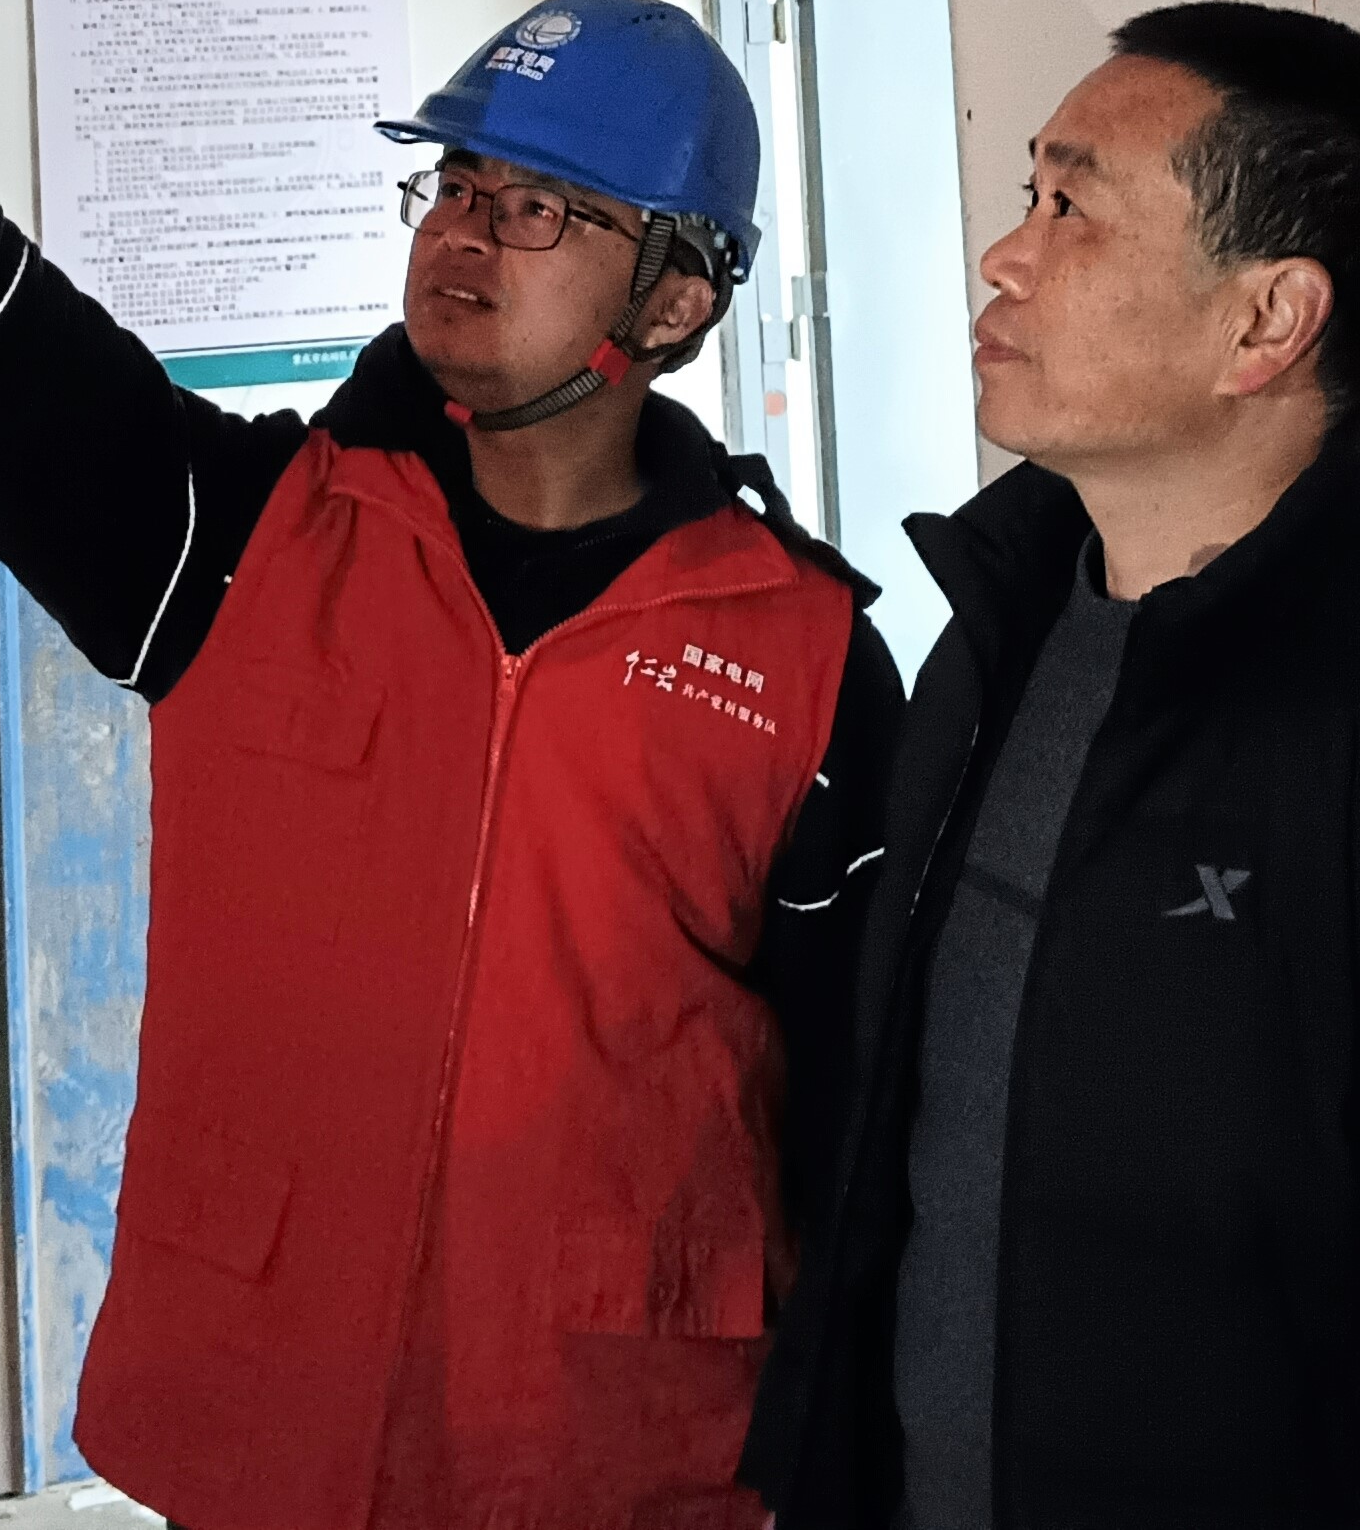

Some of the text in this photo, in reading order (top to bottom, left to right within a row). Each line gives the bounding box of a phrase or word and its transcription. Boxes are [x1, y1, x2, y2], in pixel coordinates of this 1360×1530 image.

[682, 644, 765, 694] 国家电网
[681, 682, 778, 738] 共产党员服务队
